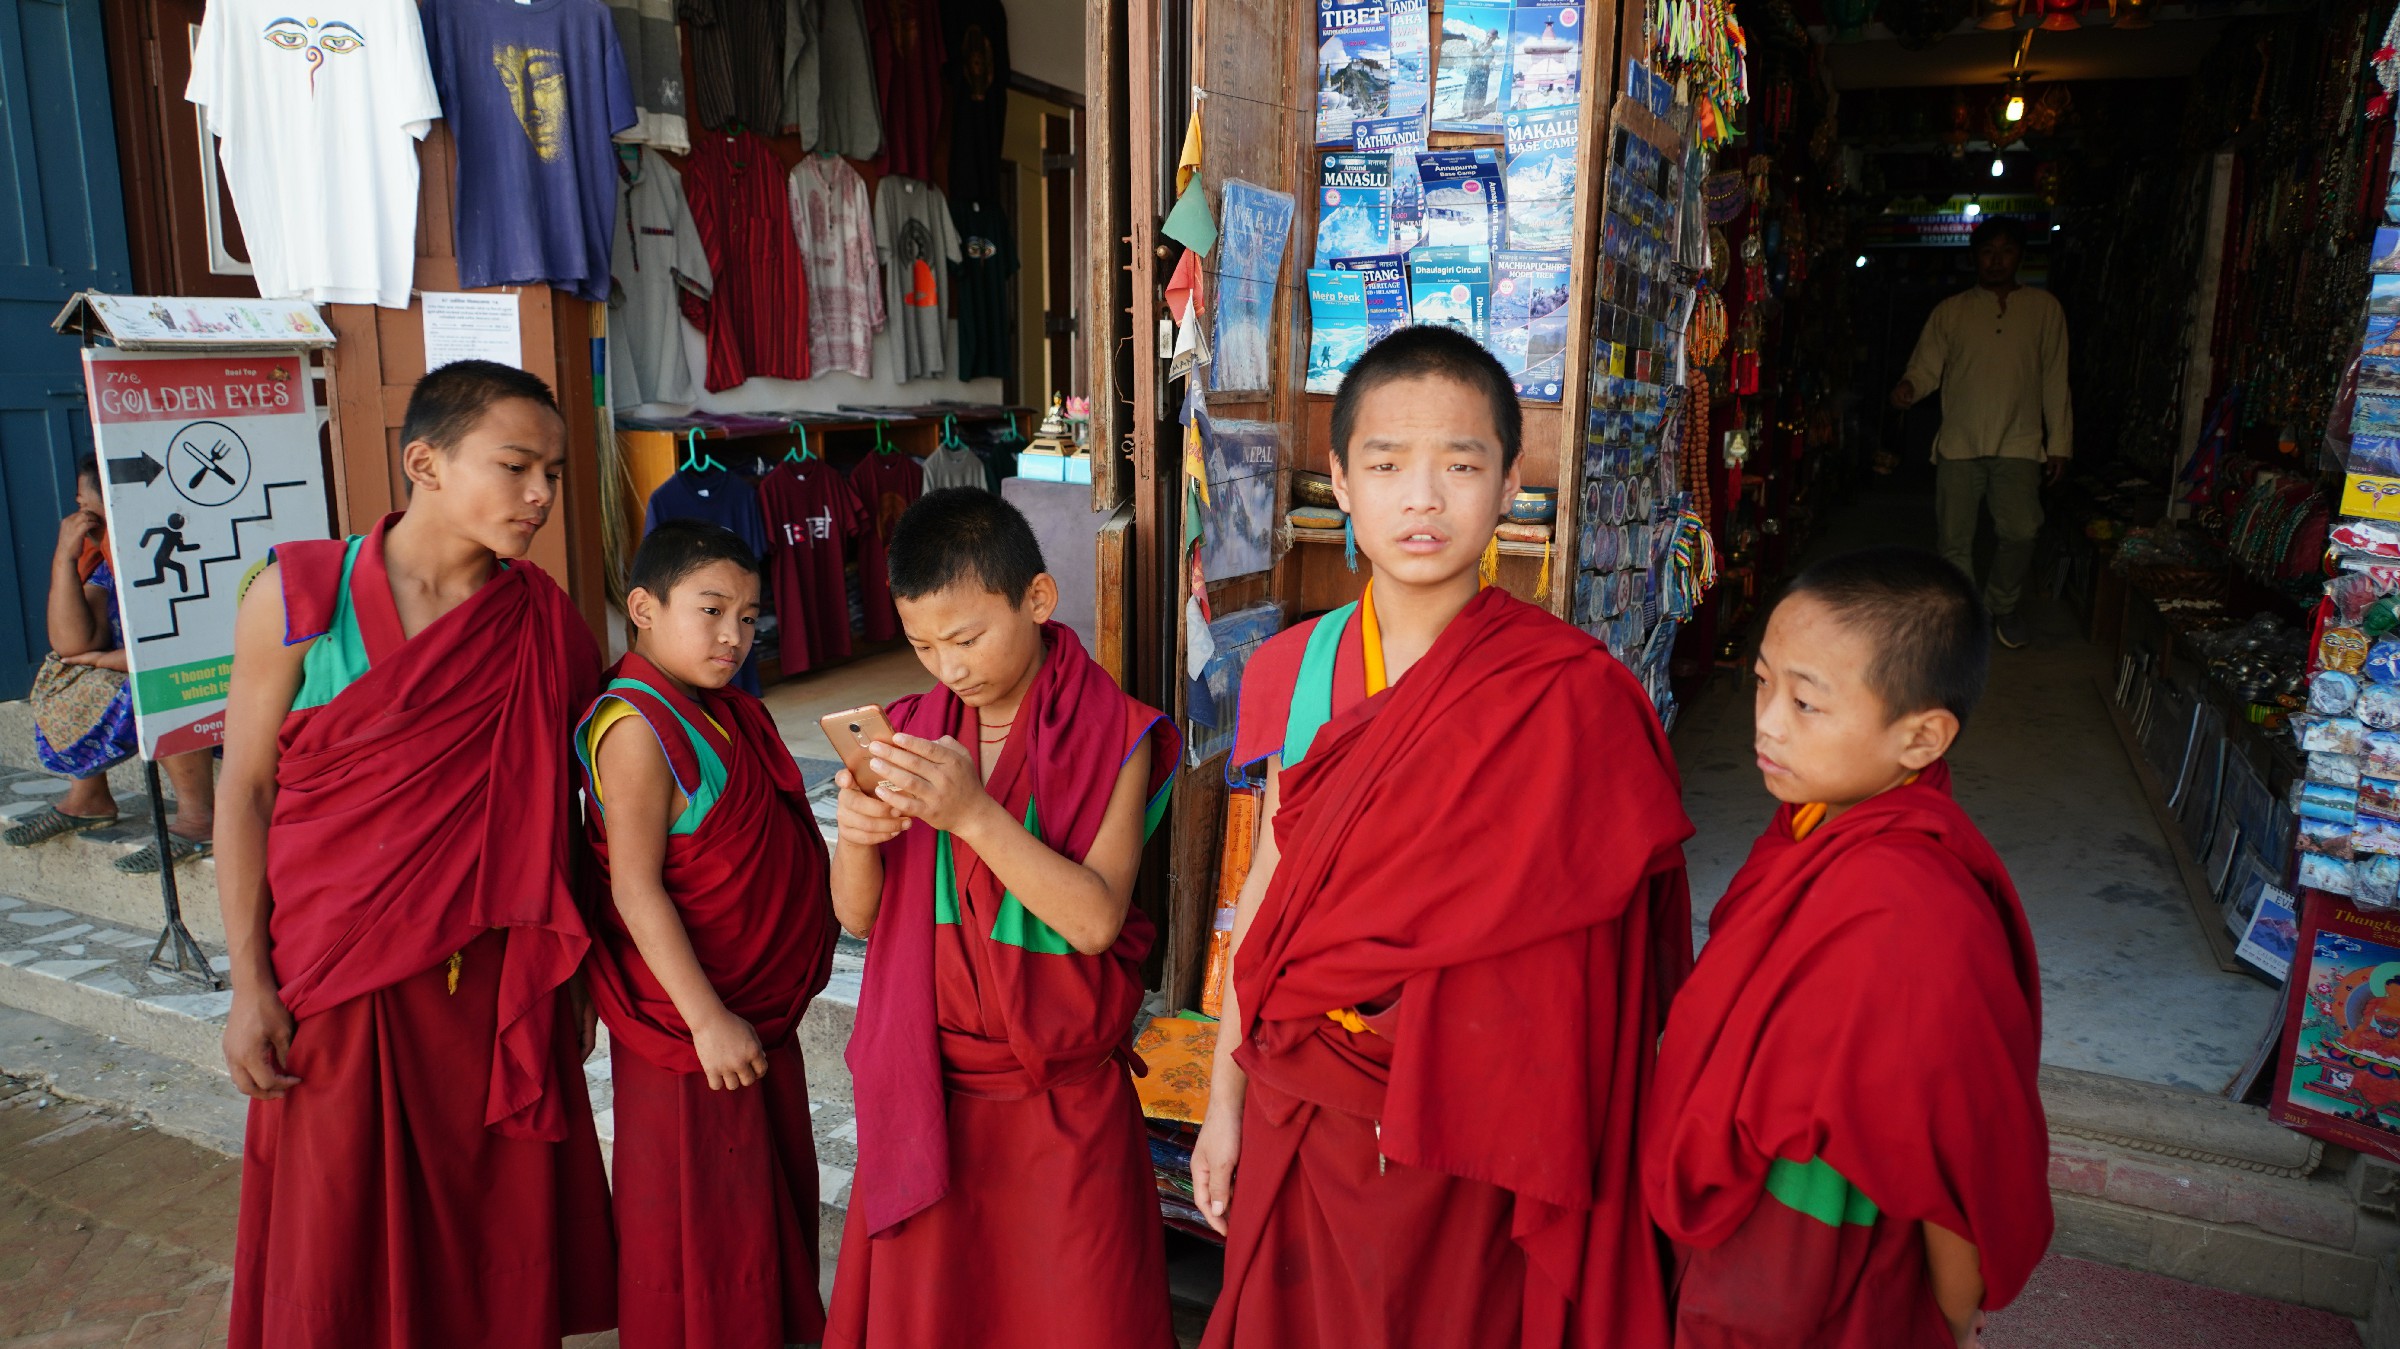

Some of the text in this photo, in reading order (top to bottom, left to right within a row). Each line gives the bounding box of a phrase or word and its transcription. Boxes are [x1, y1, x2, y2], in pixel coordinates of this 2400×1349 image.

[1321, 7, 1385, 28] TIBET
[1508, 119, 1578, 142] MAKALU
[1357, 131, 1420, 149] KATHMANDU
[1508, 136, 1578, 154] BASE CAMP
[1435, 164, 1478, 173] Annapurna
[1324, 172, 1388, 187] MANASLU
[1488, 181, 1499, 224] Annapurna
[1415, 265, 1482, 275] Dhaulagiri Circuit
[1498, 261, 1567, 272] MACHHAPUCHHRE
[1536, 271, 1555, 279] TREK
[1368, 281, 1400, 289] HERITAGE
[1312, 291, 1337, 301] Mera
[1337, 292, 1361, 301] Peak
[106, 371, 142, 385] The
[243, 368, 257, 377] Top
[101, 382, 290, 415] GOLDEN EYES
[1241, 445, 1273, 463] NEPAL
[181, 667, 216, 682] honor
[181, 685, 219, 700] which
[193, 719, 224, 735] Open
[211, 732, 219, 742] 7
